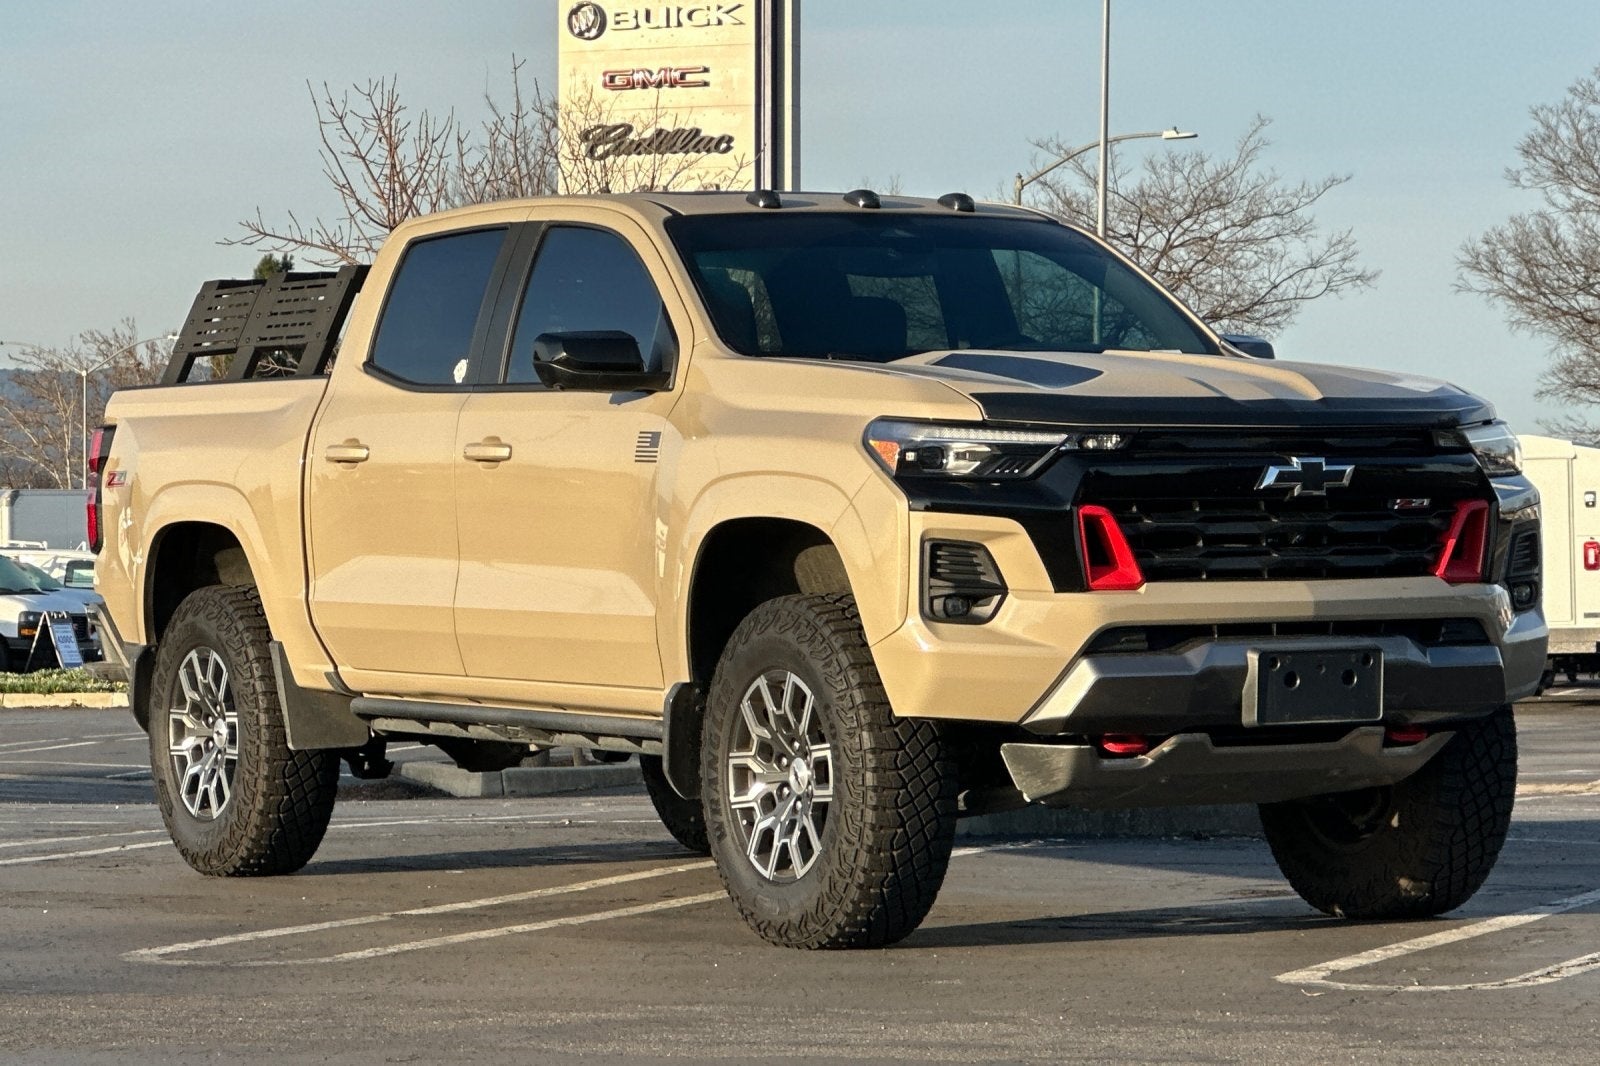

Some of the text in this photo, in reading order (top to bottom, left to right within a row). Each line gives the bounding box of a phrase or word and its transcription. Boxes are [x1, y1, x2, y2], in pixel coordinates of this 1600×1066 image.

[611, 3, 746, 31] BUICK
[602, 66, 710, 91] GMC
[580, 122, 735, 161] Cadillac
